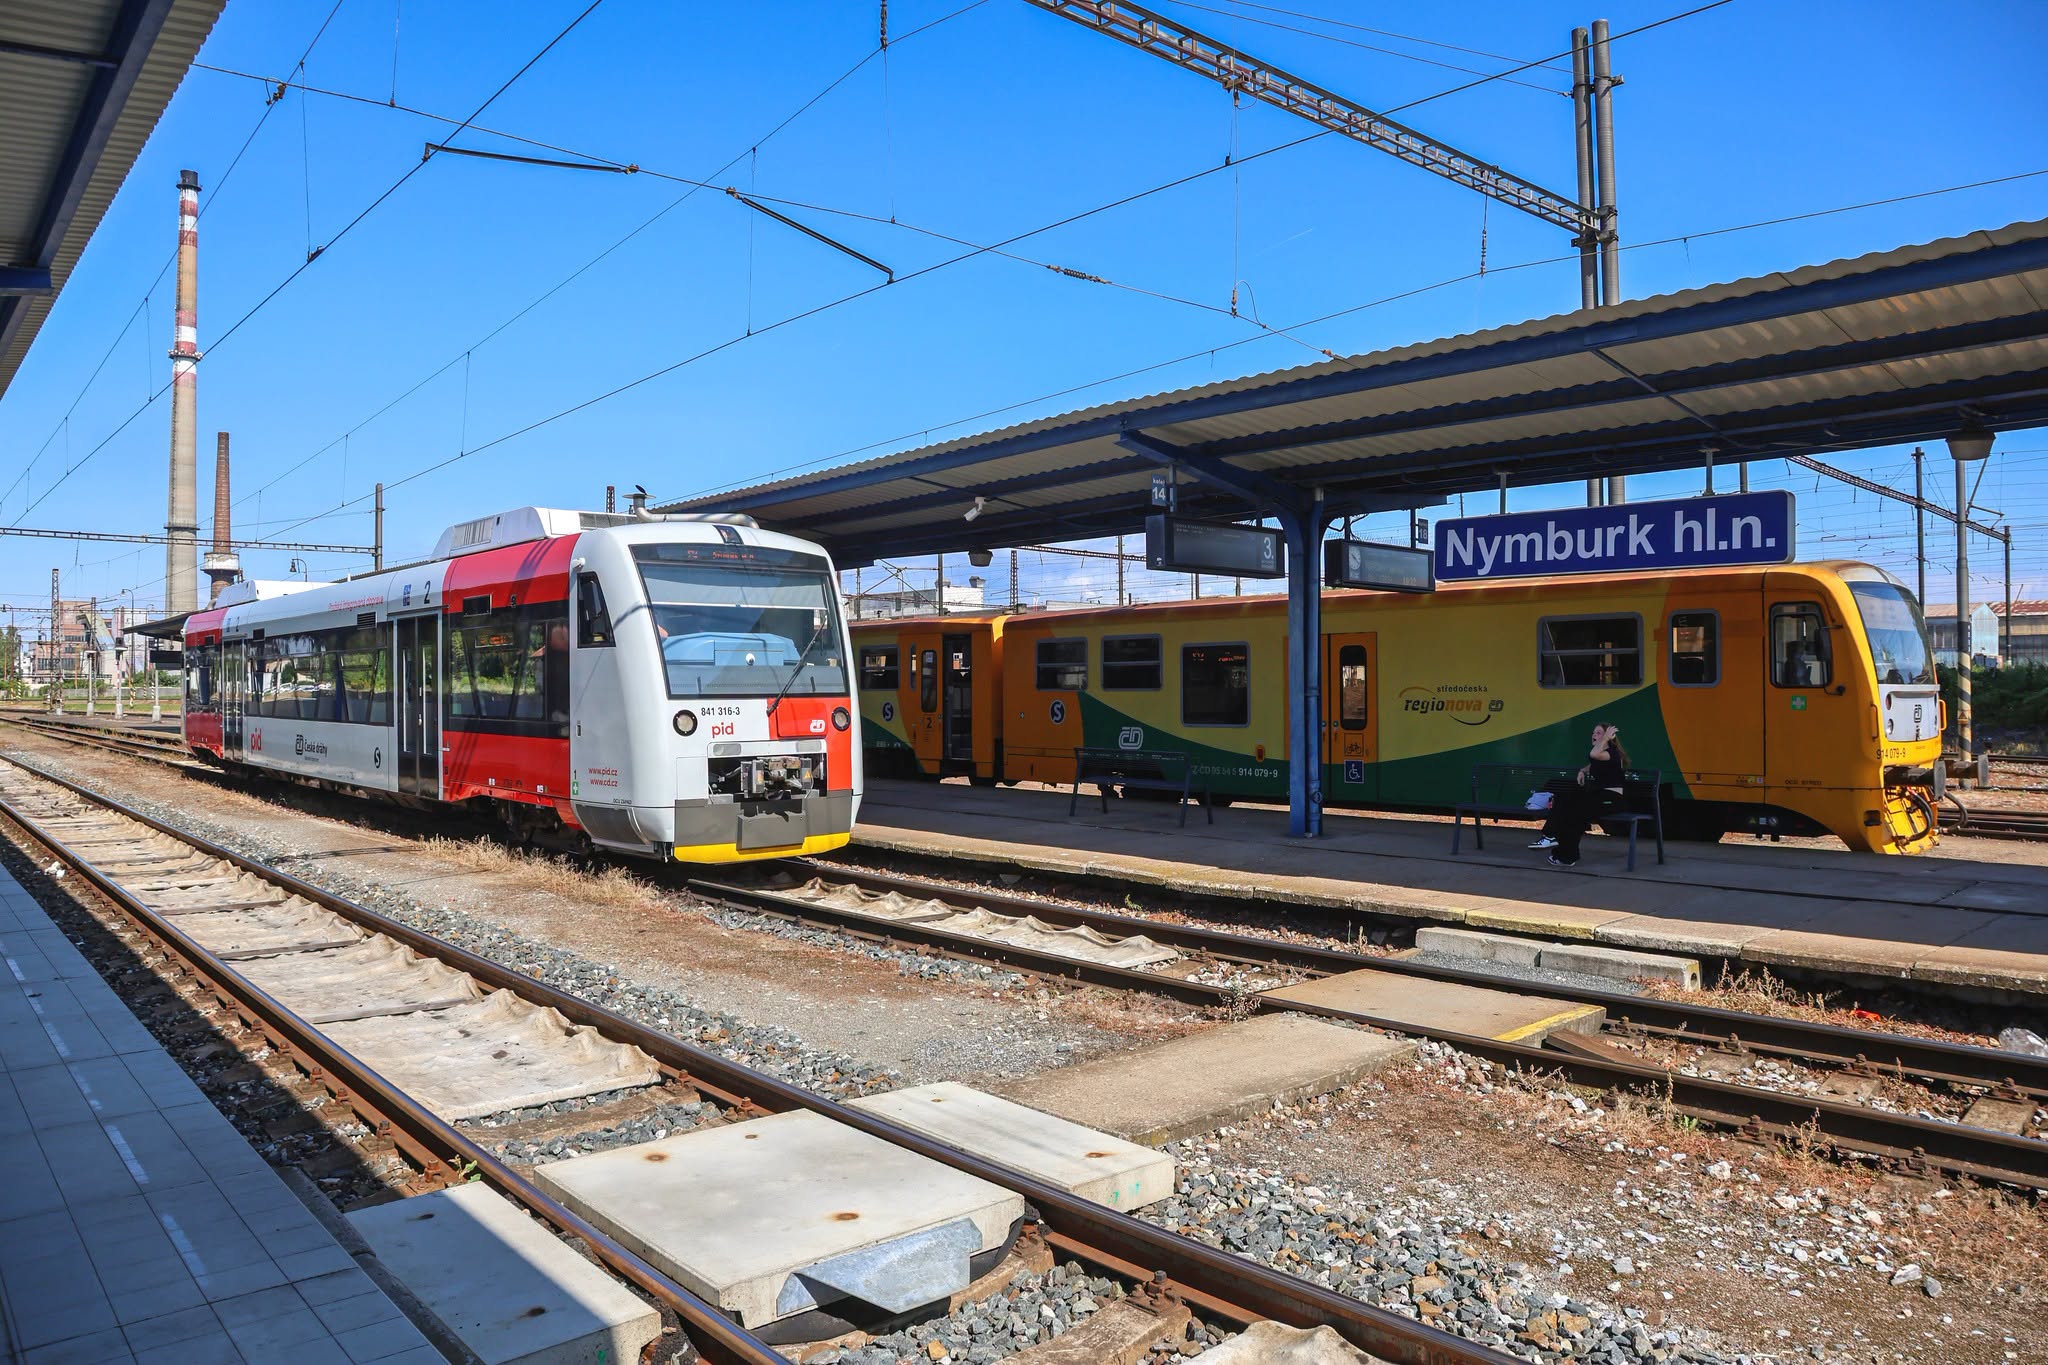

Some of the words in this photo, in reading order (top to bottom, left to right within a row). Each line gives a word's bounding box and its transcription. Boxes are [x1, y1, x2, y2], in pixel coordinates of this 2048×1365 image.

[1152, 487, 1166, 500] 14
[1418, 528, 1428, 540] 18
[1446, 514, 1655, 575] Nymburk
[1674, 508, 1776, 553] hl.n.
[1263, 537, 1274, 560] 3.
[424, 580, 431, 604] 2
[700, 707, 715, 717] 841
[718, 706, 741, 716] 316-3
[1404, 697, 1482, 714] regionova
[926, 717, 933, 729] 2
[711, 721, 734, 739] pid
[250, 727, 262, 755] pid
[588, 767, 618, 777] www.pid.cz
[1239, 767, 1252, 777] 914
[1254, 768, 1278, 778] 079-9
[590, 778, 618, 787] www.cd.cz
